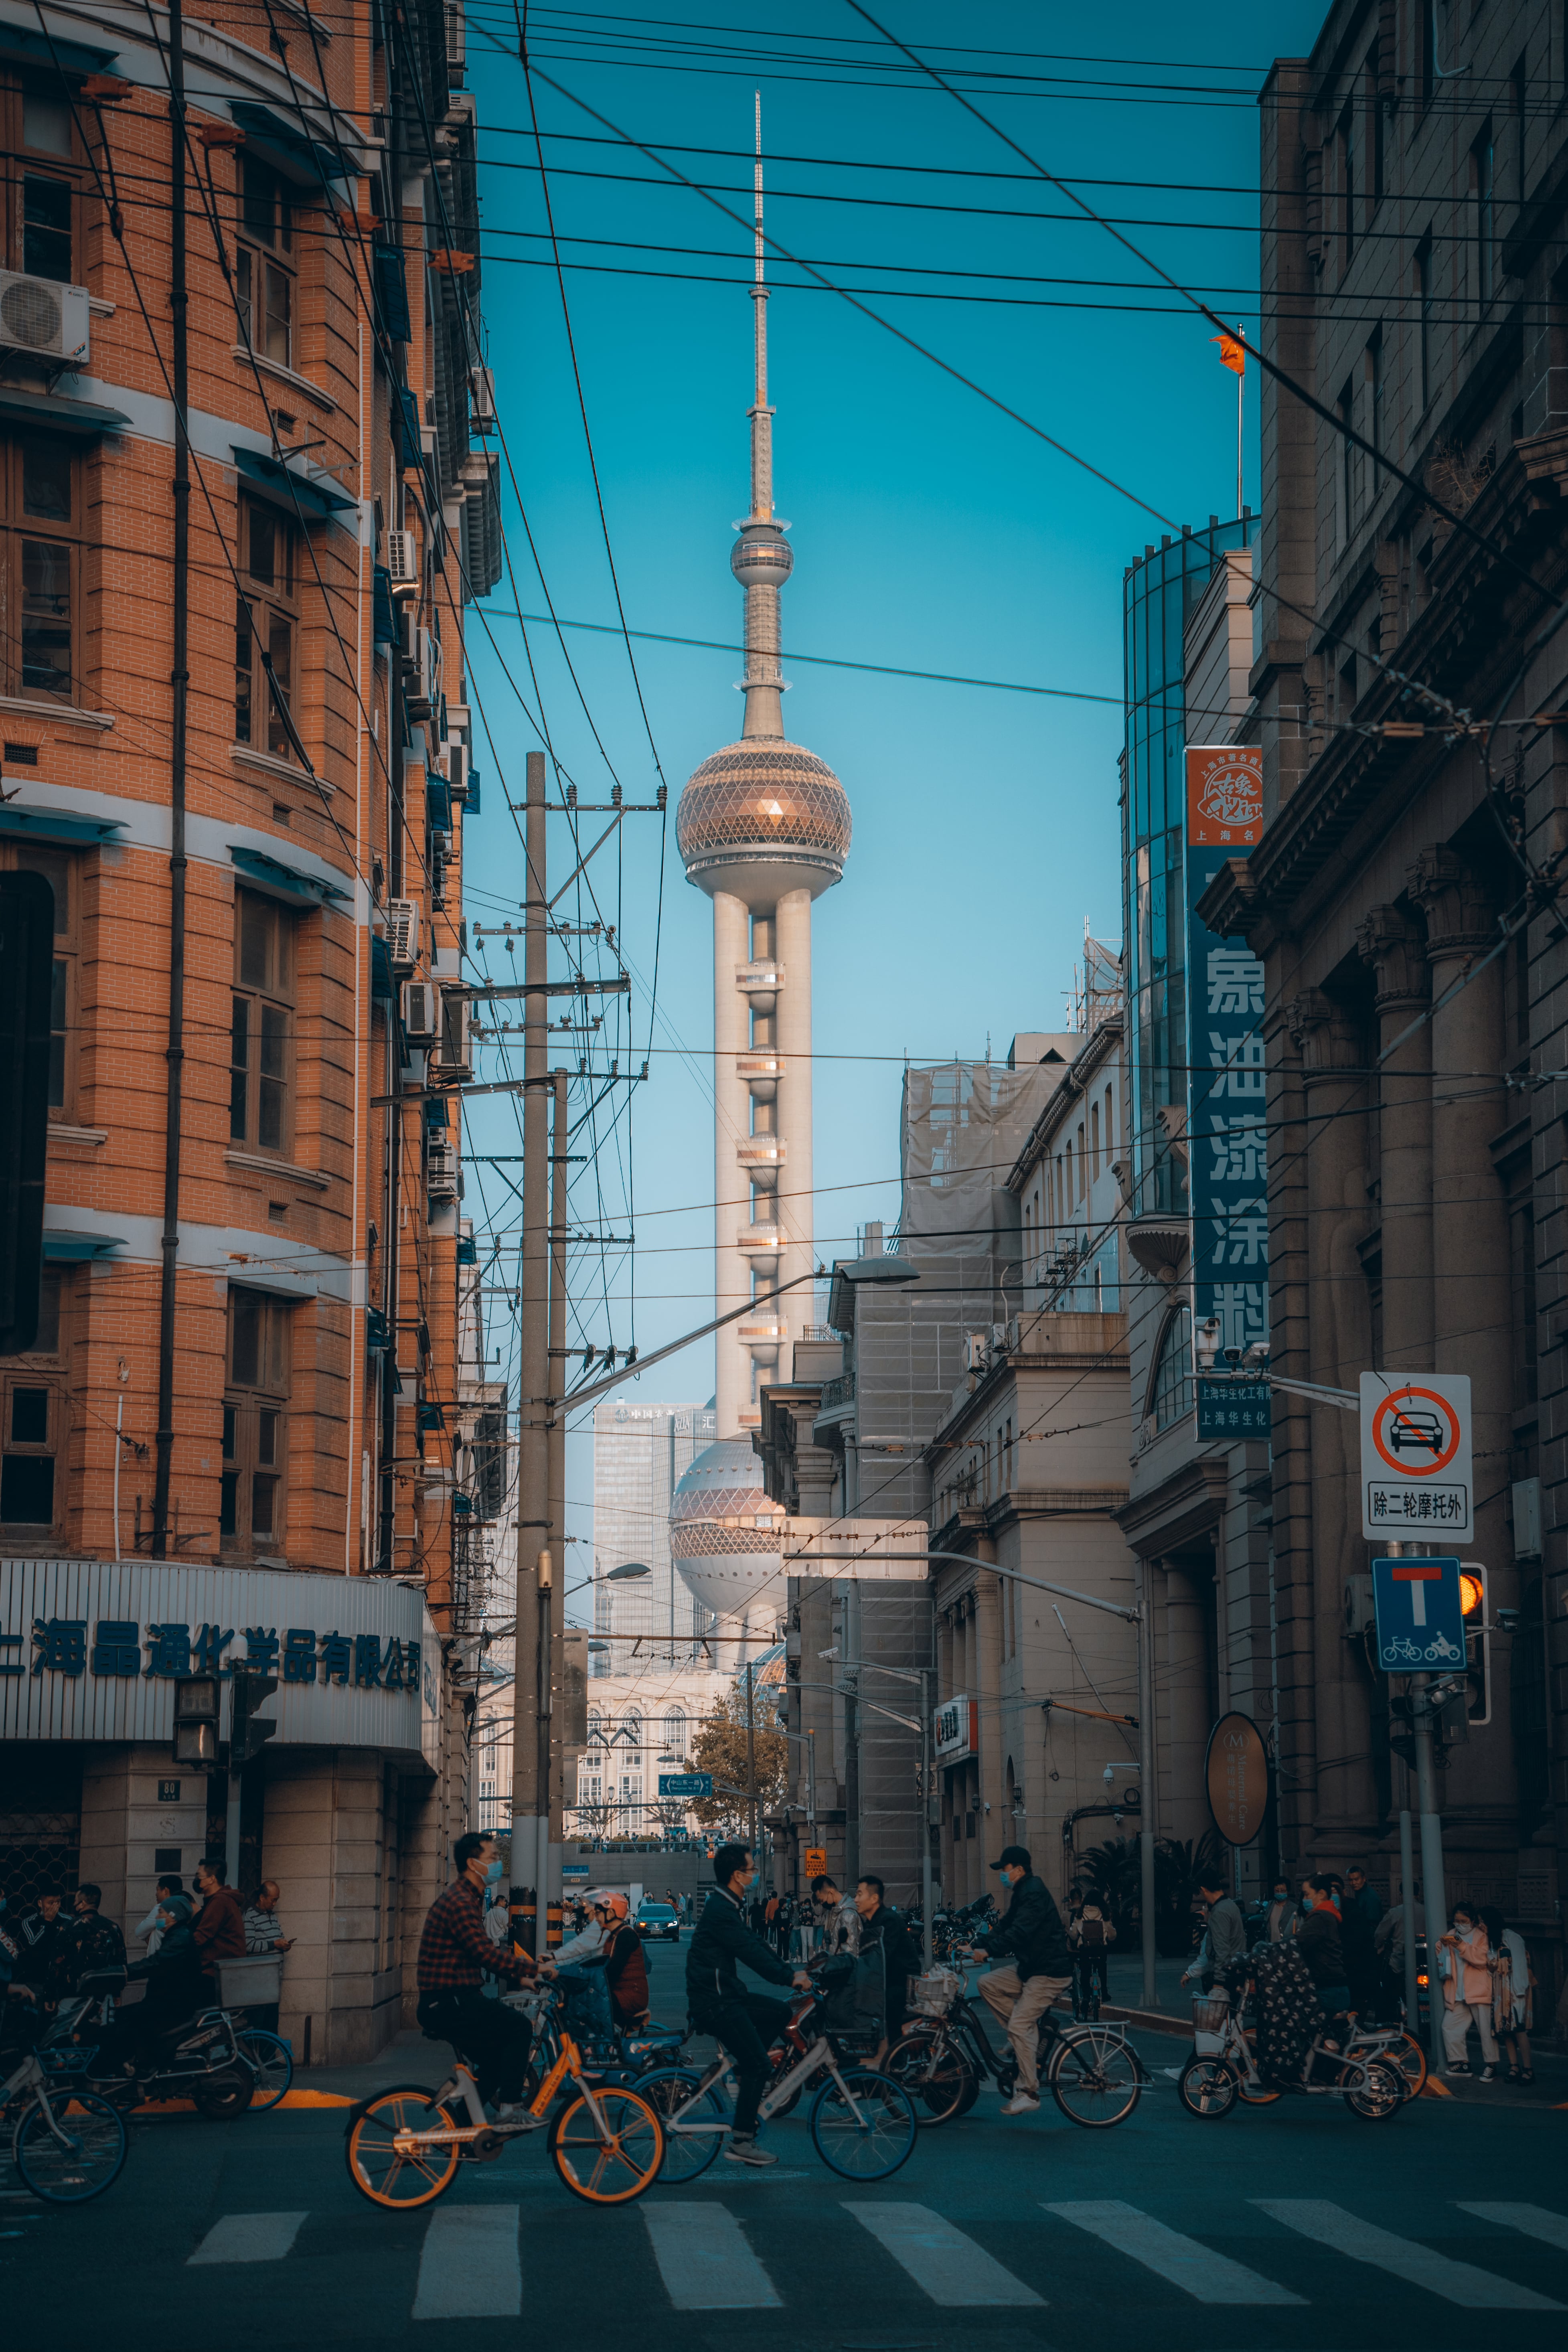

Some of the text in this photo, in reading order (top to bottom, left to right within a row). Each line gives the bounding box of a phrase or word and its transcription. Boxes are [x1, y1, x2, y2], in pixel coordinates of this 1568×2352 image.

[1205, 873, 1269, 1347] 象油漆涂料
[631, 1409, 685, 1419] 中国农业
[1201, 1411, 1266, 1426] 上海华生化
[702, 1416, 715, 1428] 汇
[1374, 1491, 1462, 1520] 除二轮摩托外
[1230, 1734, 1244, 1747] M
[164, 1783, 174, 1794] 80
[1238, 1754, 1248, 1830] Maternal Care
